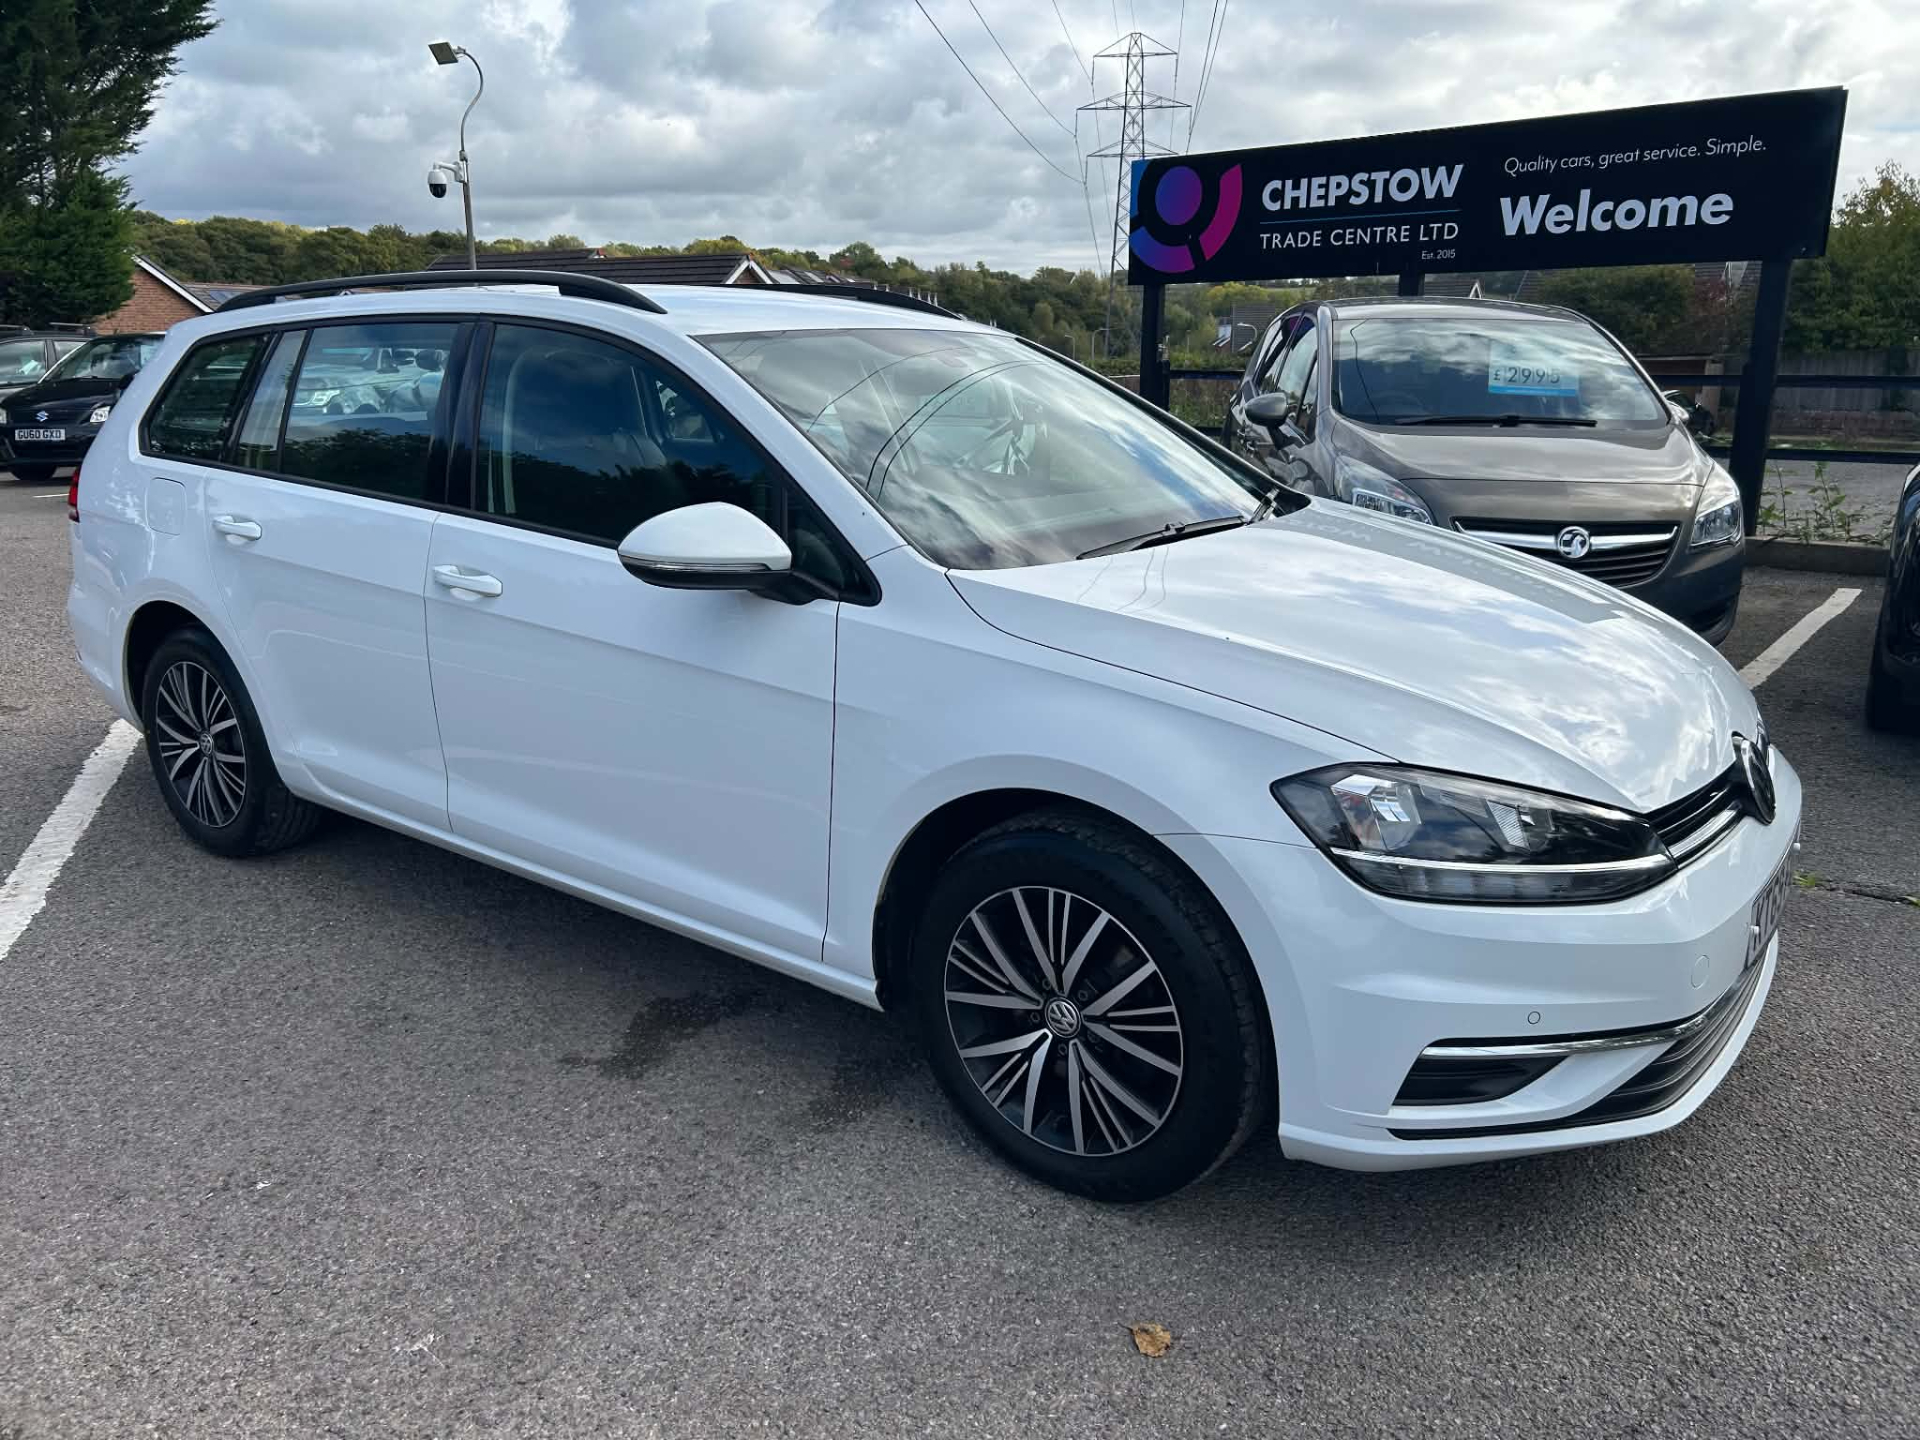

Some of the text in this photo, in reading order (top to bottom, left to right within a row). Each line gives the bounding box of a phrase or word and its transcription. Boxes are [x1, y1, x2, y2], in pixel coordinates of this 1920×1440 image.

[1504, 134, 1767, 177] Quality cars, great service. Simple.
[1261, 164, 1464, 211] CHEPSTOW
[1500, 188, 1734, 236] Welcome
[1259, 222, 1460, 250] TRADE CENTRE LTD
[1421, 248, 1456, 260] Est. 2015
